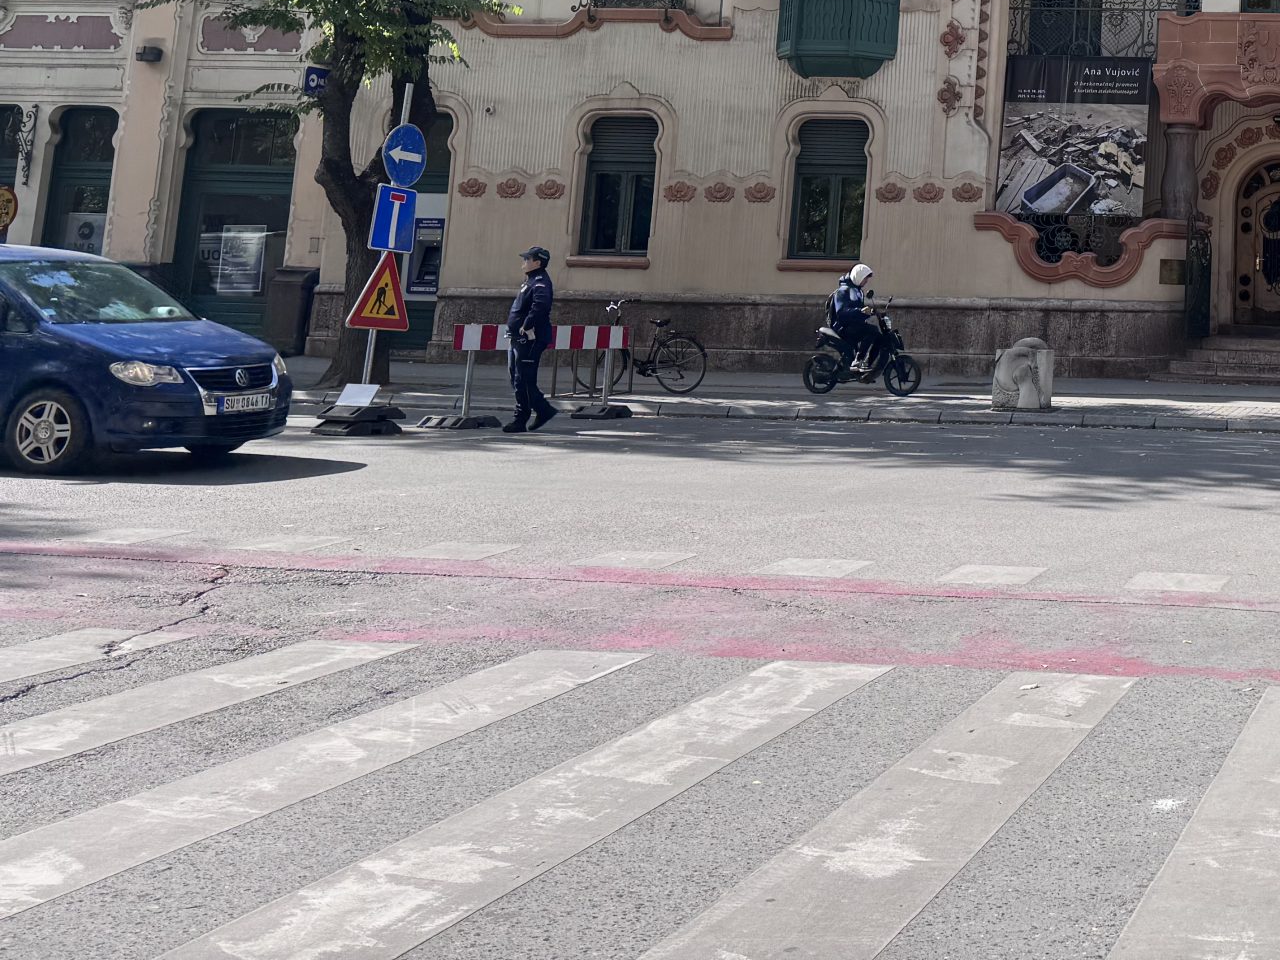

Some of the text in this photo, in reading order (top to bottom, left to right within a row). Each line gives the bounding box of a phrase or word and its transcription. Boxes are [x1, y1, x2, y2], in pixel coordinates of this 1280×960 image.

[1083, 67, 1140, 77] Ana Vujović
[225, 398, 236, 409] SU
